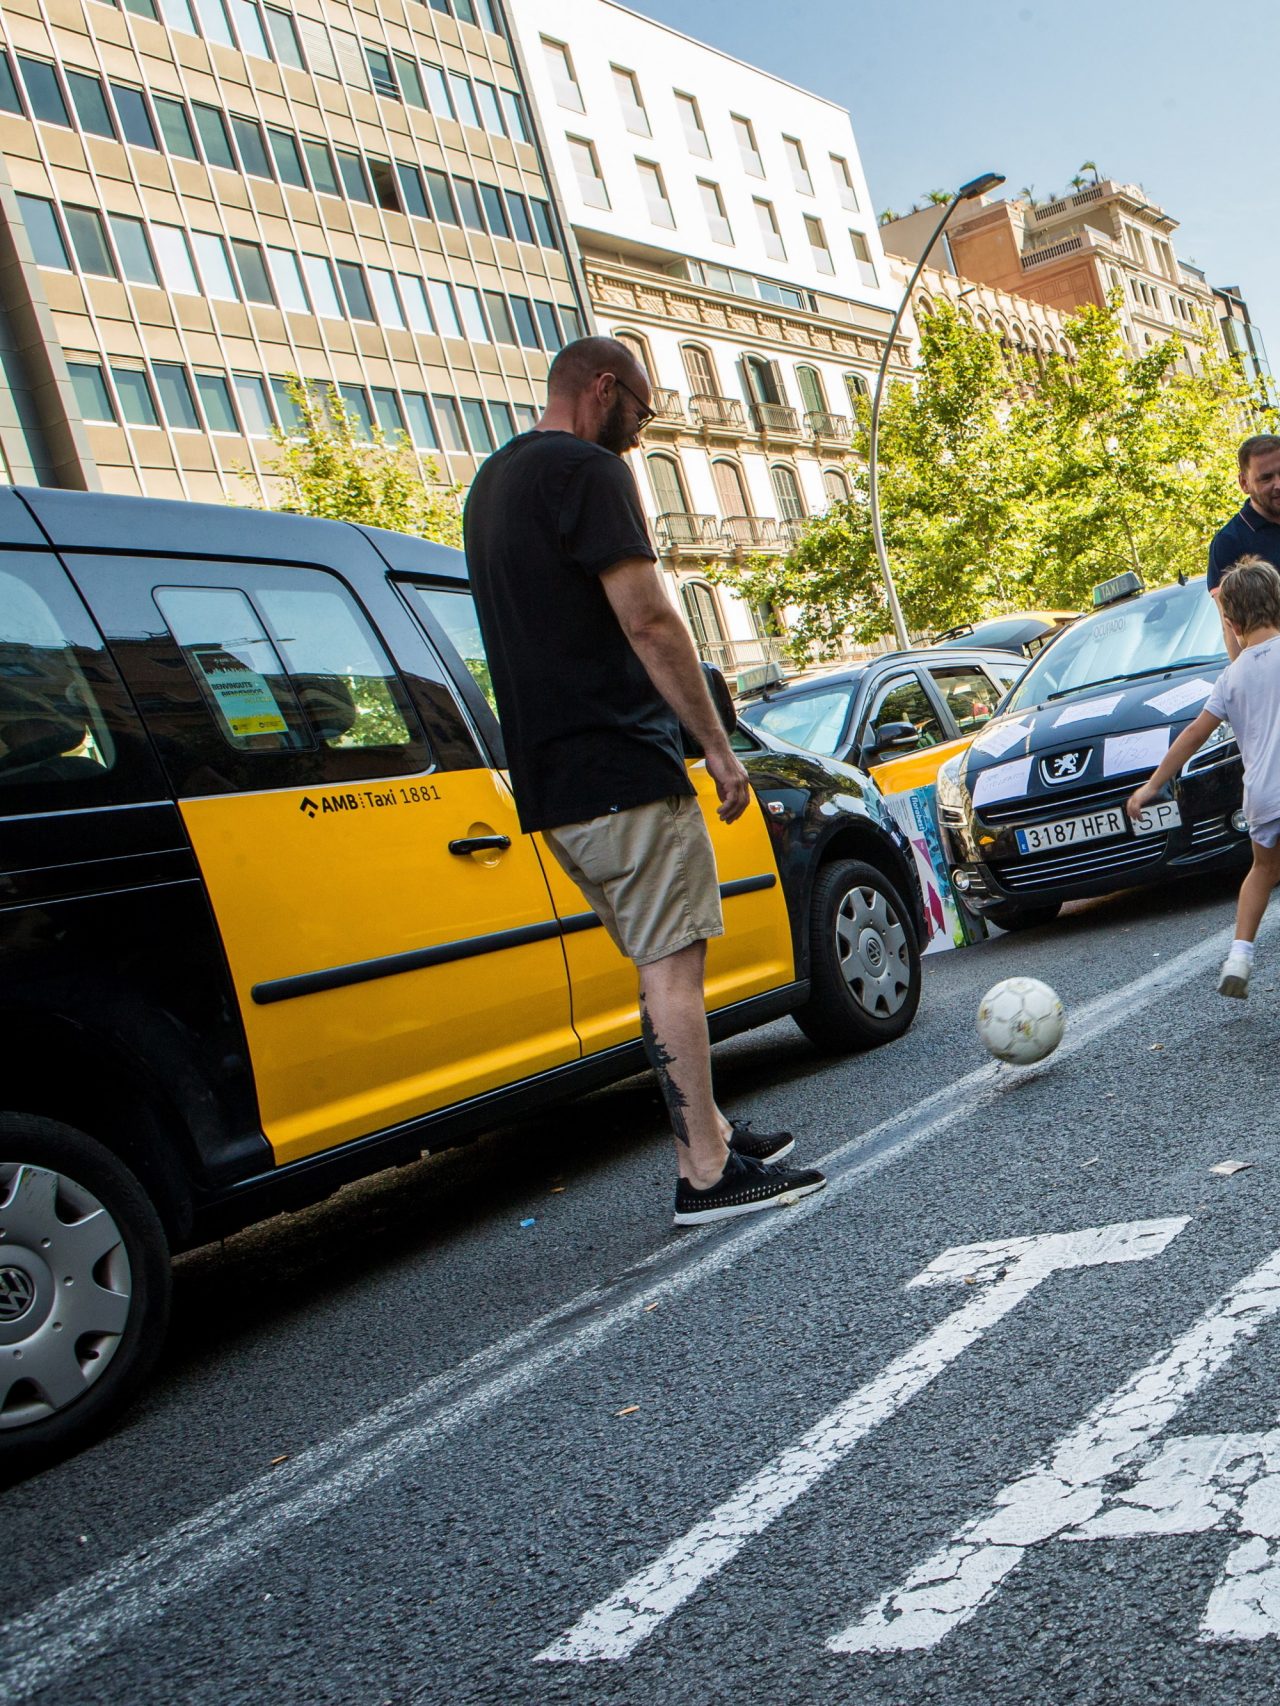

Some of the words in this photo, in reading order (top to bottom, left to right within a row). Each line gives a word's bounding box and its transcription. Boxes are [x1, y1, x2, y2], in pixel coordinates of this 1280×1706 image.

[1101, 582, 1120, 600] TAXI
[322, 794, 359, 813] AMB
[363, 788, 398, 808] Taxi
[400, 785, 442, 804] 1881
[1029, 821, 1076, 848] 3187
[1082, 812, 1121, 838] HFR
